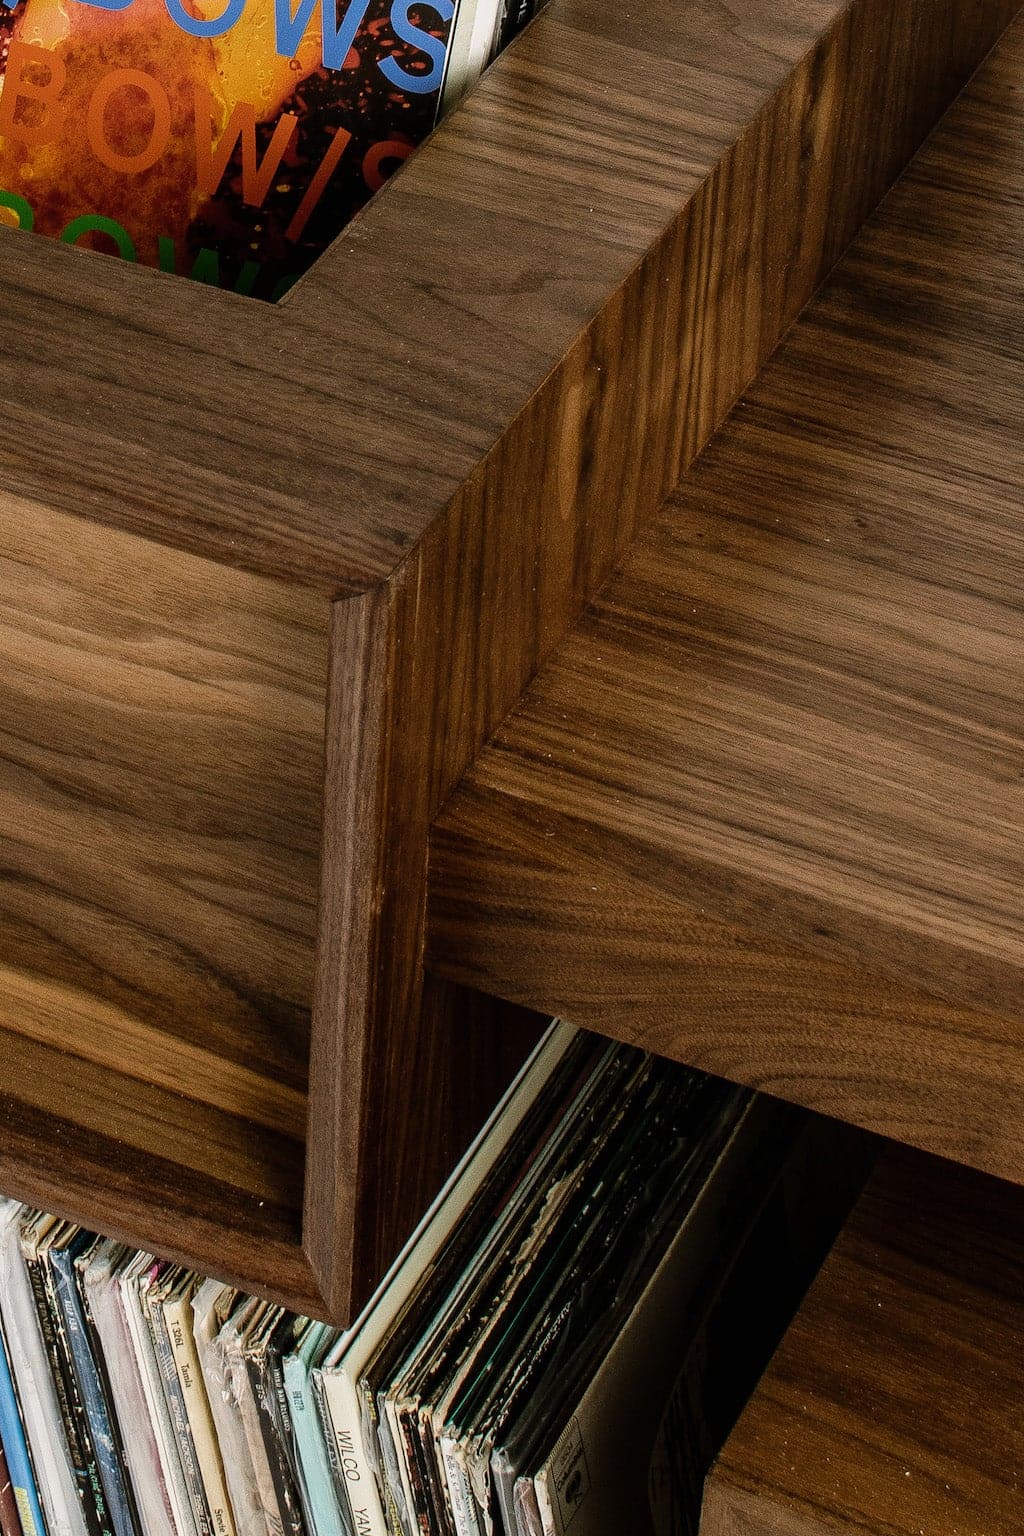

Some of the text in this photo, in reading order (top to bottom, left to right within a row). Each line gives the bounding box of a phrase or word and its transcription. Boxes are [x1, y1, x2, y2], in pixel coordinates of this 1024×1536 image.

[171, 1326, 183, 1349] 326L
[180, 1364, 192, 1389] Tamla
[212, 1507, 228, 1534] Stevie
[334, 1428, 363, 1484] WILCO
